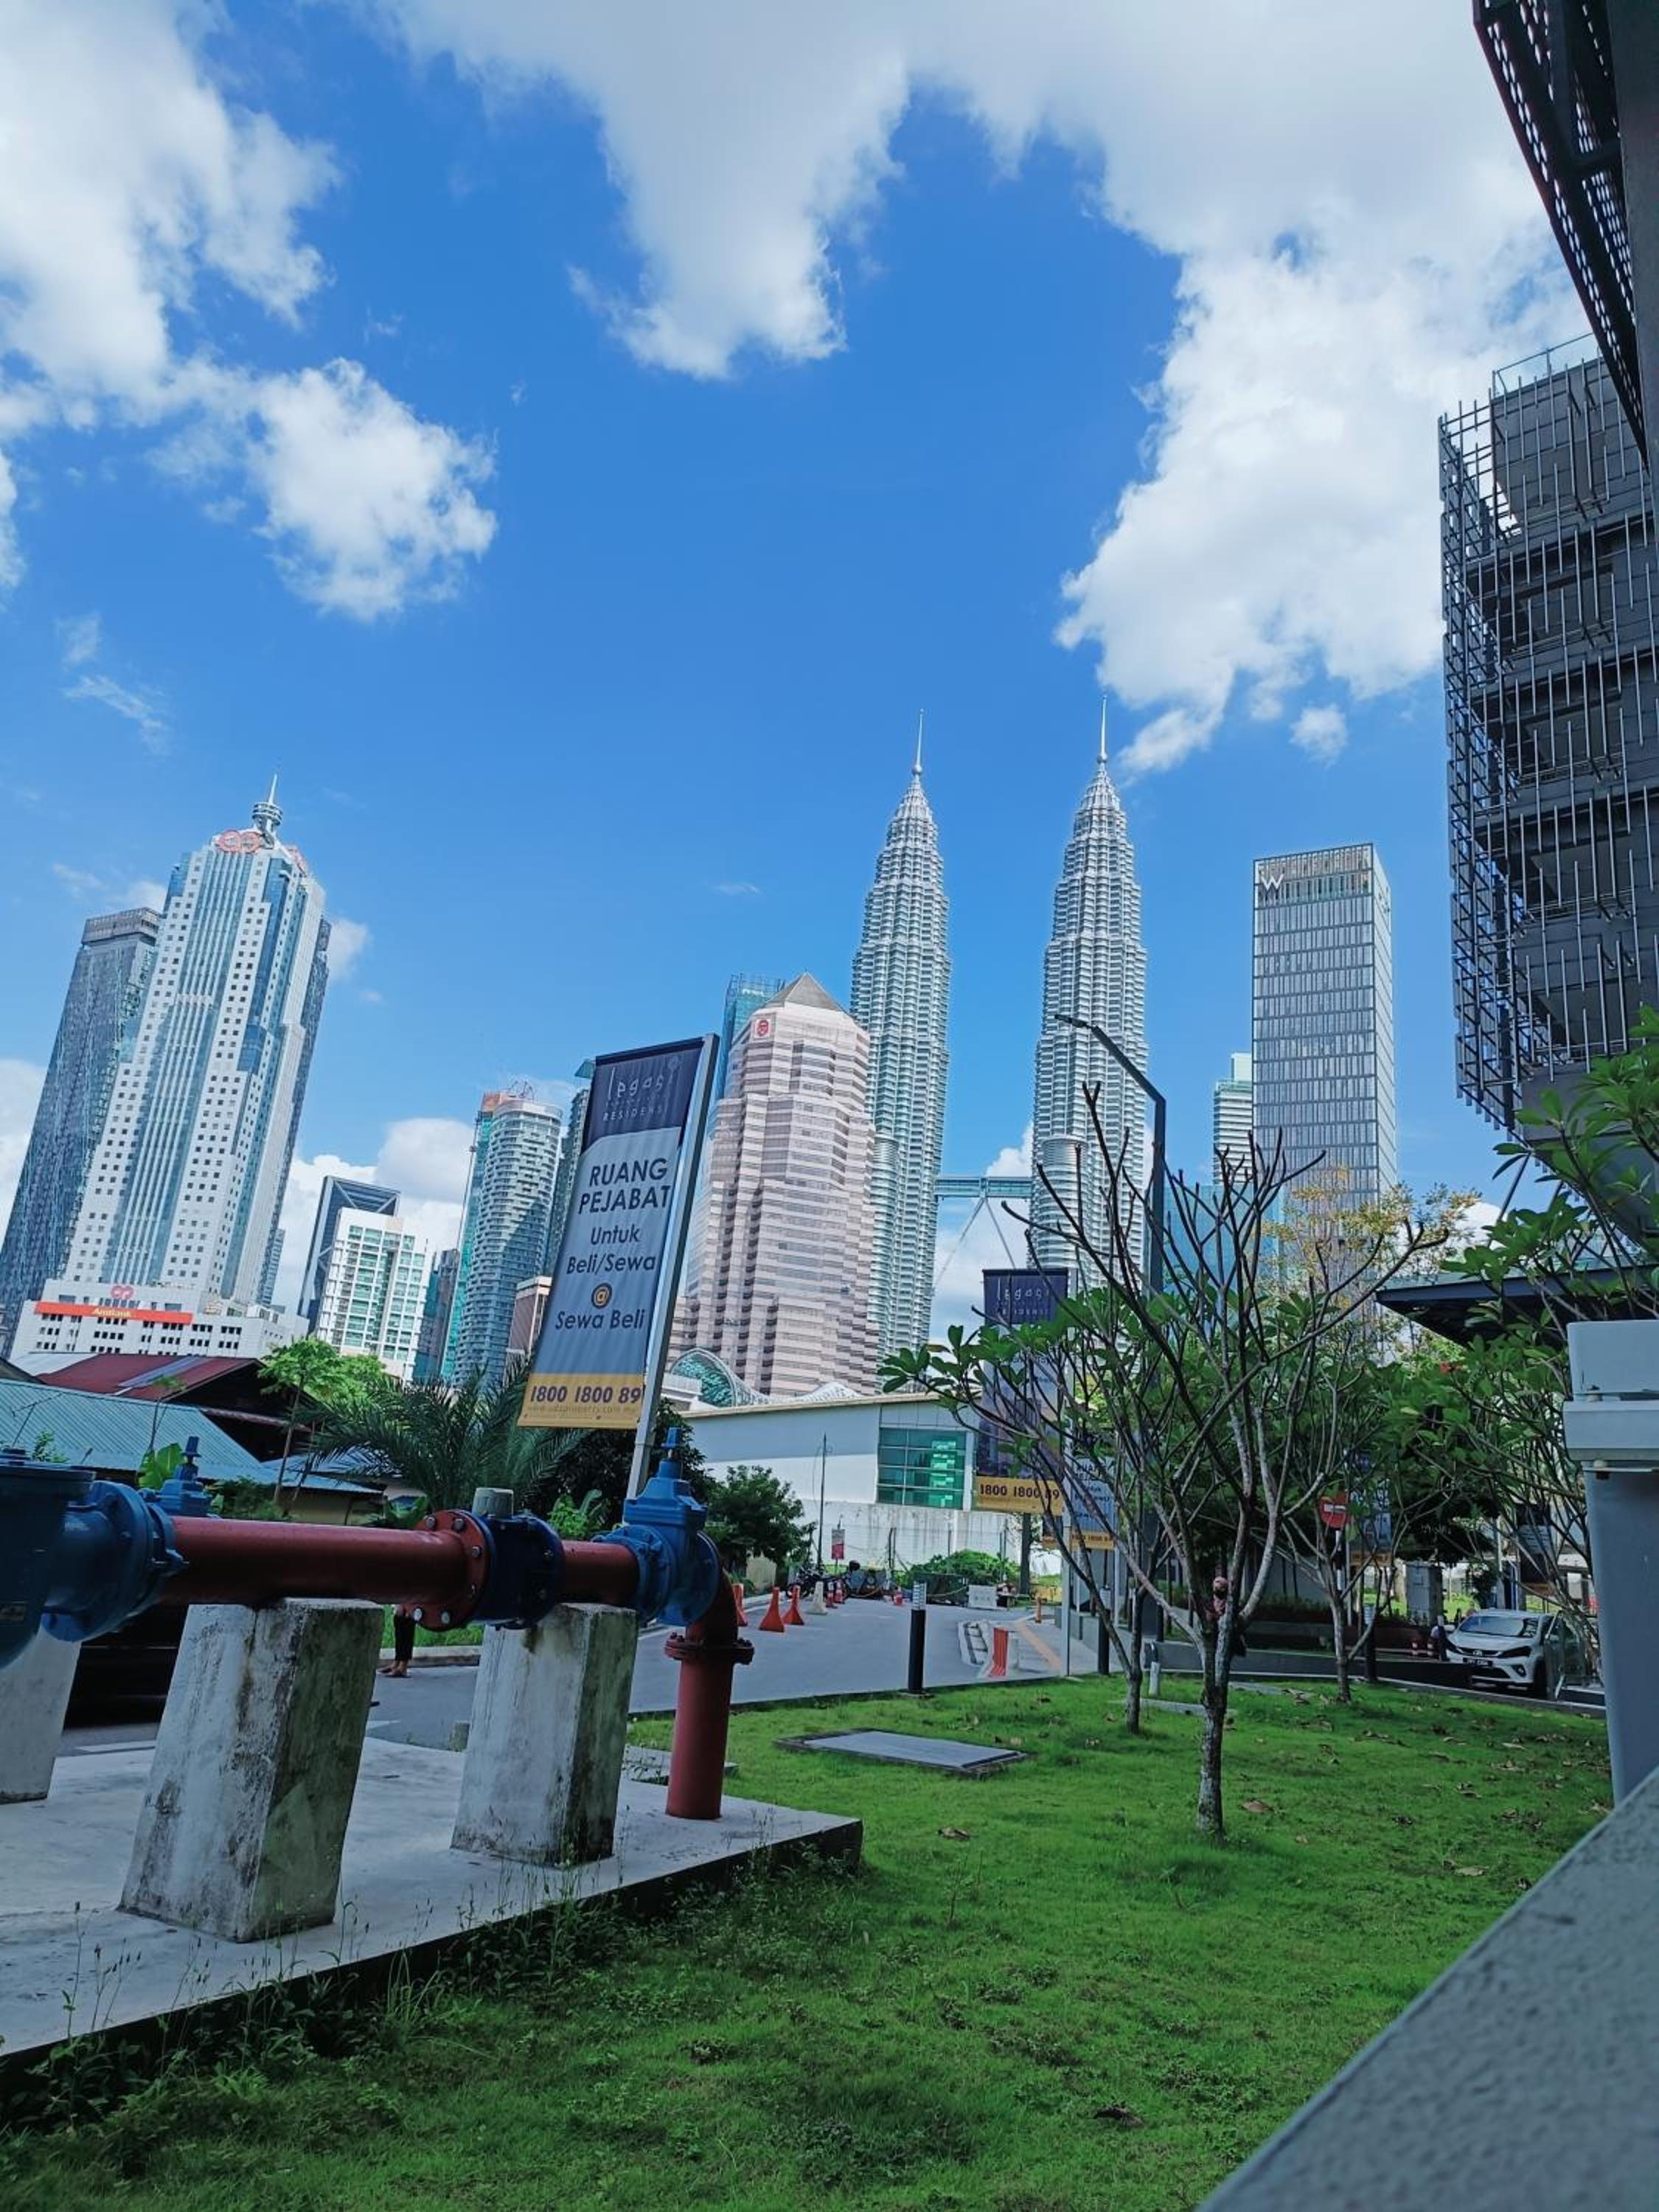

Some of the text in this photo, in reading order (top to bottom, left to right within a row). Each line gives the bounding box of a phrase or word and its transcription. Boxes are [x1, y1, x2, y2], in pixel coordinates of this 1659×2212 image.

[1261, 874, 1284, 891] W
[590, 1158, 667, 1186] RUANG
[578, 1186, 671, 1214] PEJABAT
[591, 1223, 640, 1245] Untuk
[566, 1253, 655, 1274] Beli/Sewa
[555, 1309, 645, 1329] Sewa Beli
[531, 1385, 567, 1402] 1800
[574, 1385, 613, 1403] 1800
[980, 1484, 1007, 1496] 1800
[1013, 1486, 1041, 1499] 1800
